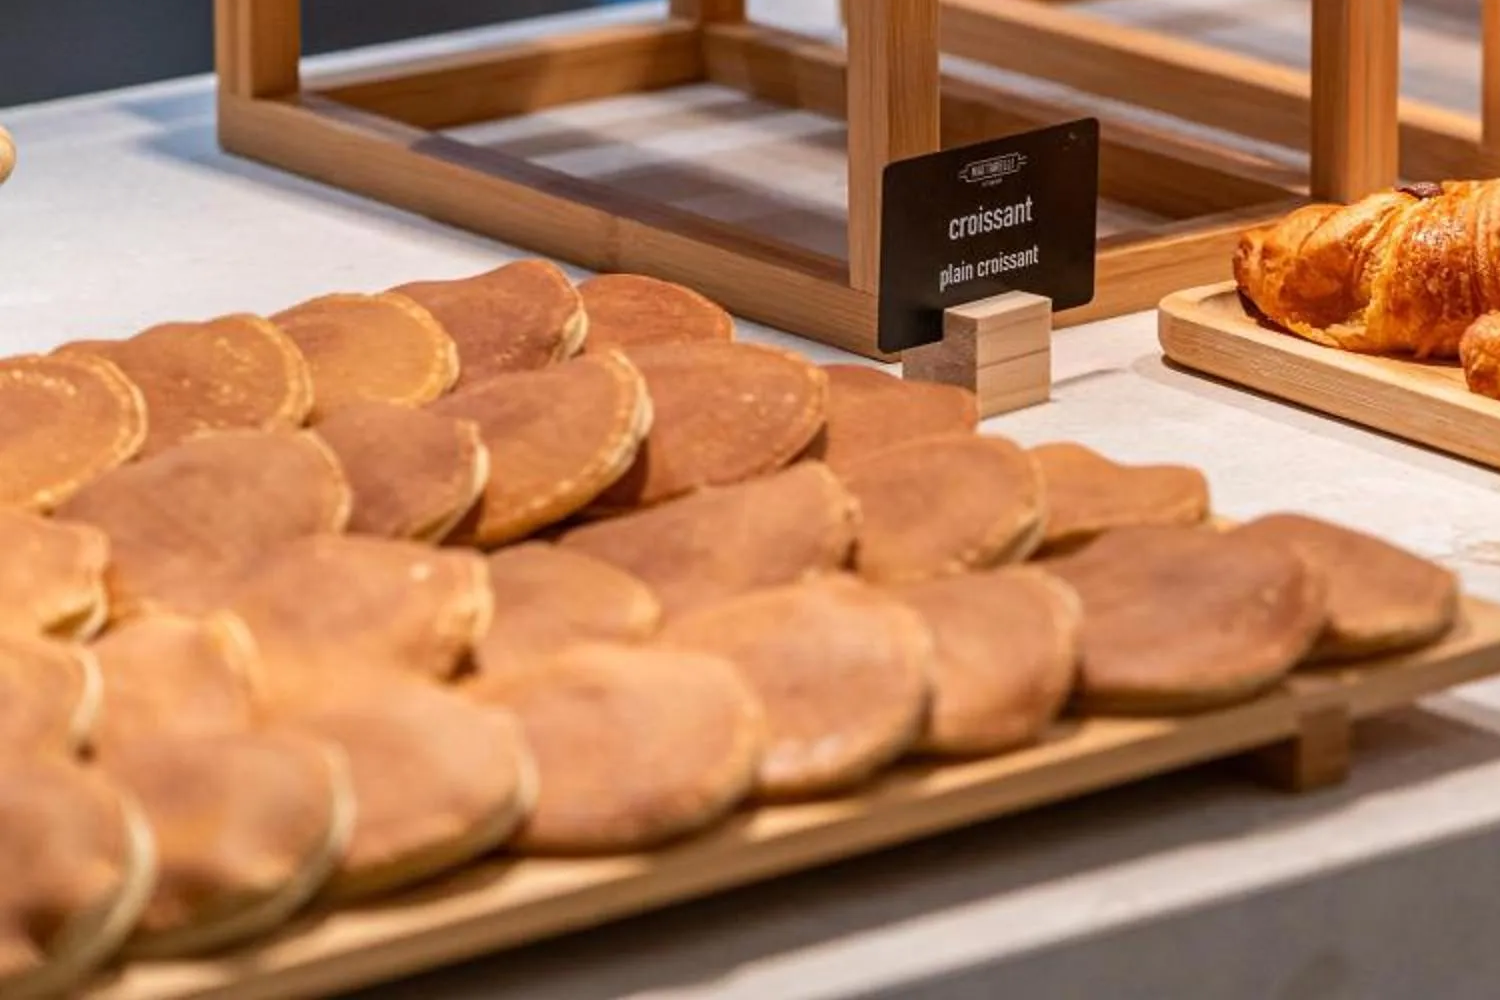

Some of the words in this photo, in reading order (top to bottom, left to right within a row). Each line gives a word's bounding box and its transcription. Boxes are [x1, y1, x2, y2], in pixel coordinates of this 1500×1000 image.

[948, 195, 1033, 240] croissant
[939, 261, 973, 293] plain
[976, 244, 1039, 278] croissant
